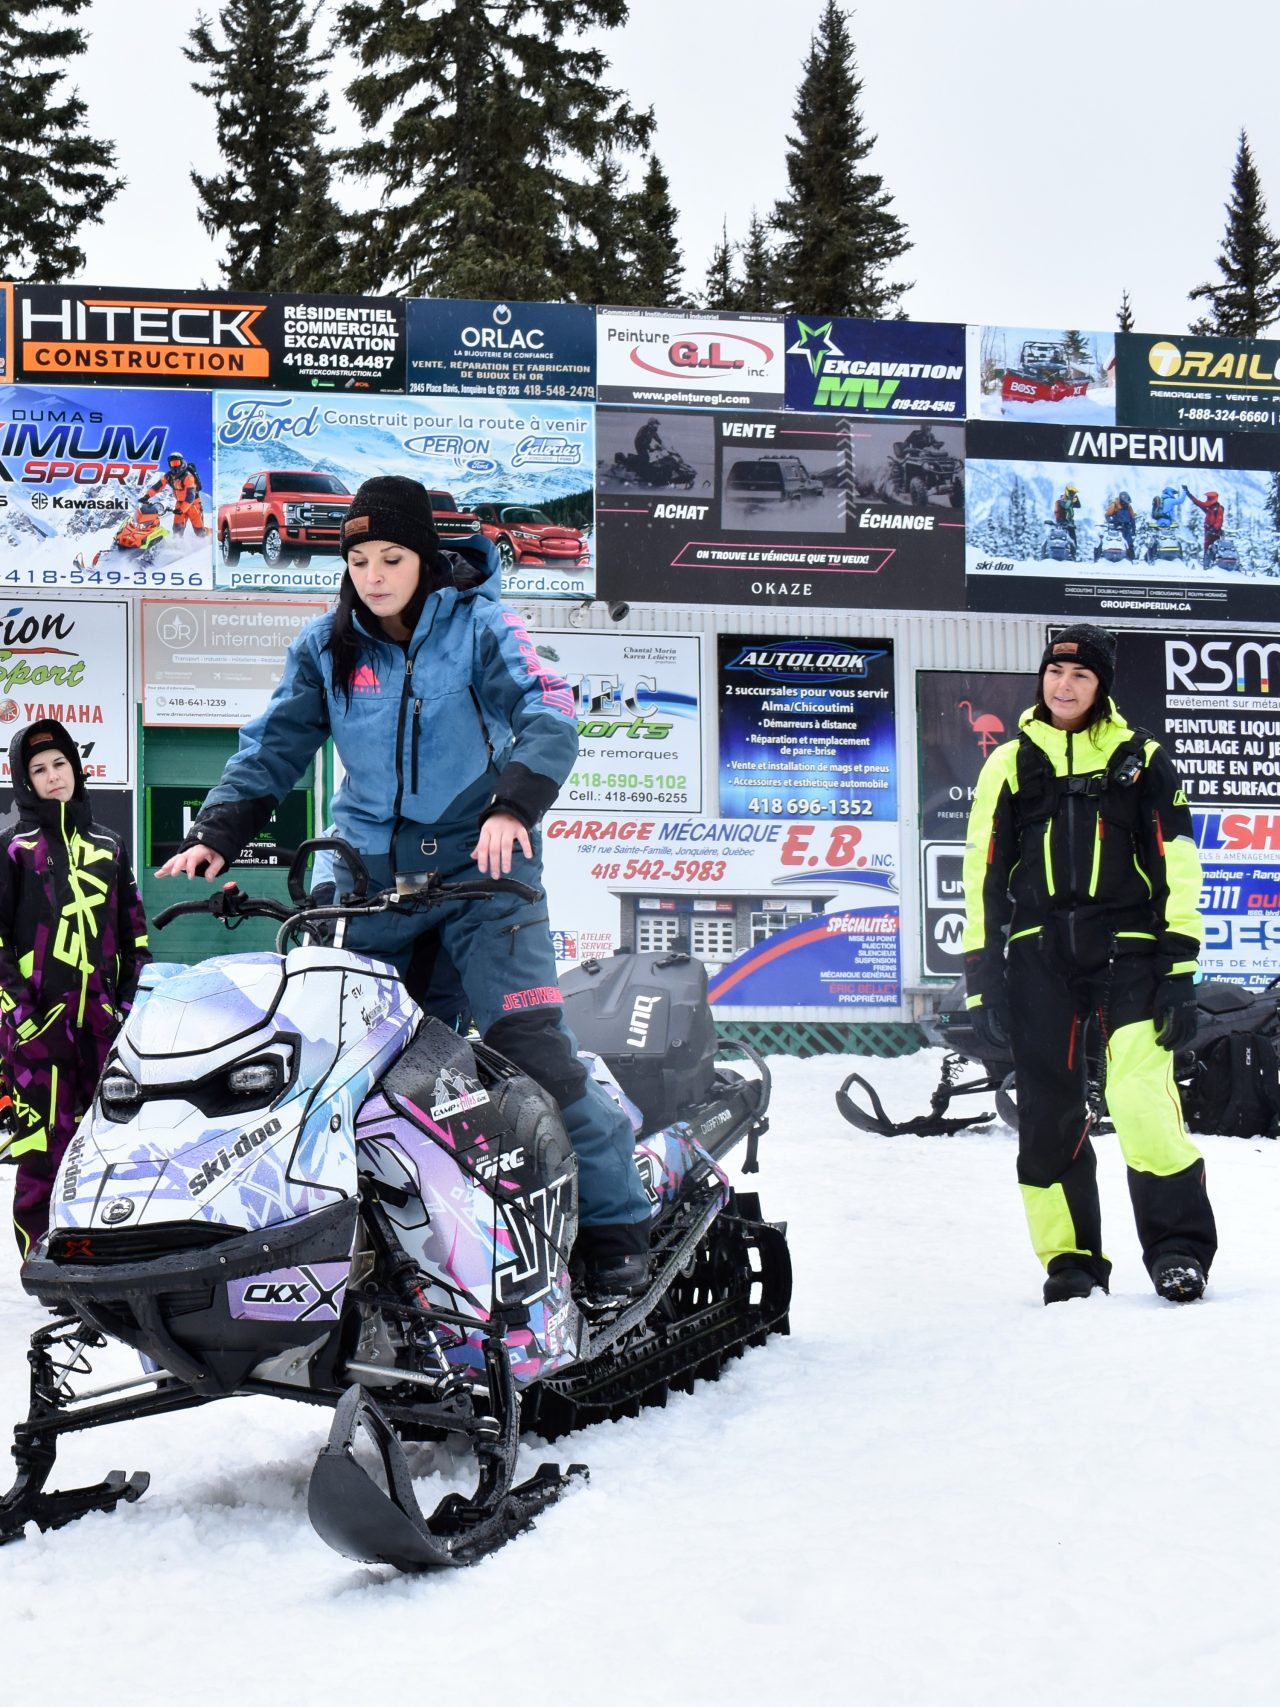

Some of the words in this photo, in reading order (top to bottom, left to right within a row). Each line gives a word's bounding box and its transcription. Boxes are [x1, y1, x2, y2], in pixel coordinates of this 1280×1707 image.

[284, 304, 396, 322] RÉSIDENTIEL
[22, 299, 263, 346] HITECK
[284, 321, 399, 337] COMMERCIAL
[284, 335, 396, 351] EXCAVATION
[461, 327, 544, 349] ORLAC
[608, 328, 670, 344] Peinture
[35, 348, 245, 372] CONSTRUCTION
[283, 353, 394, 369] 418.818.4487
[464, 350, 501, 358] BIJOUTERIE
[668, 341, 744, 369] G.L.
[450, 361, 509, 371] RÉPARATION
[527, 365, 590, 373] FABRICATION
[748, 367, 769, 377] inc.
[822, 360, 963, 380] EXCAVATION
[477, 372, 510, 380] BIJOUX
[426, 383, 441, 392] Place
[524, 385, 595, 397] 418-548-2479
[814, 376, 900, 409] MV
[1010, 381, 1036, 395] BOSS
[633, 391, 750, 405] www.peinturegl.com
[892, 399, 956, 412] 819-823-4545
[1226, 394, 1258, 402] VENTE
[13, 409, 103, 424] DUMAS
[219, 399, 319, 445] Ford
[323, 410, 408, 427] Construit
[413, 416, 453, 431] pour
[458, 414, 478, 429] la
[480, 417, 524, 432] route
[530, 415, 540, 431] à
[545, 419, 588, 432] venir
[1178, 408, 1268, 422] 1-888-324-6660
[722, 422, 776, 439] VENTE
[1068, 431, 1224, 462] IMPERIUM
[22, 461, 159, 486] SPORT
[53, 496, 129, 510] Kawasaki
[654, 504, 709, 521] ACHAT
[859, 509, 935, 531] ÉCHANGE
[696, 550, 709, 560] ON
[711, 551, 747, 562] TROUVE
[749, 552, 759, 561] LE
[761, 550, 806, 562] VÉHICULE
[808, 553, 826, 564] QUE
[828, 554, 840, 564] TU
[842, 555, 869, 565] VEUX!
[976, 561, 1014, 572] ski-doo
[5, 570, 203, 586] 418-549-3956
[751, 582, 813, 597] OKAZE
[1100, 600, 1191, 611] GROUPEIMPERIUM.CA
[740, 652, 866, 668] AUTOLOOK
[725, 685, 733, 695] 2
[735, 686, 798, 697] succursales
[800, 688, 826, 698] pour
[829, 689, 855, 697] vous
[857, 689, 889, 698] servir
[169, 698, 227, 707] 418-641-1239
[762, 701, 853, 713] Alma/Chicoutimi
[1169, 697, 1229, 708] revêtement
[1233, 699, 1248, 708] sur
[24, 703, 104, 724] YAMAHA
[764, 719, 813, 729] Démarreurs
[815, 720, 820, 729] à
[822, 721, 857, 729] distance
[1165, 718, 1236, 734] PEINTURE
[751, 735, 797, 745] Réparation
[800, 736, 808, 744] et
[809, 737, 870, 747] remplacement
[1175, 739, 1239, 754] SABLAGE
[1243, 741, 1264, 755] AU
[601, 749, 678, 760] remorques
[780, 746, 791, 755] de
[793, 747, 836, 756] pare-brise
[731, 761, 756, 770] Vente
[758, 762, 766, 770] et
[768, 762, 816, 772] installation
[817, 763, 828, 772] de
[830, 764, 852, 773] mags
[854, 764, 863, 772] et
[864, 766, 889, 774] pneus
[1230, 761, 1248, 775] EN
[569, 773, 687, 789] 418-690-5102
[734, 777, 781, 786] Accessoires
[784, 778, 792, 787] et
[840, 779, 888, 789] automobile
[1199, 780, 1218, 795] DE
[605, 792, 687, 803] 418-690-6255
[749, 798, 783, 813] 418
[787, 799, 873, 815] 696-1352
[546, 820, 655, 841] GARAGE
[658, 819, 782, 842] MÉCANIQUE
[577, 845, 596, 854] 1981
[598, 846, 611, 854] rue
[613, 846, 674, 855] Sainte-Famille,
[722, 847, 755, 857] Québec
[780, 824, 867, 868] E.B.
[871, 853, 895, 867] INC.
[591, 863, 620, 879] 418
[623, 858, 727, 882] 542-5983
[52, 822, 113, 969] FXR
[827, 914, 896, 932] SPÉCIALITÉS:
[580, 933, 611, 941] ATELIER
[580, 942, 612, 950] SERVICE
[839, 994, 897, 1002] PROPRIÉTAIRE
[434, 1105, 456, 1117] CAMP
[188, 1118, 282, 1197] ski-doo
[63, 1136, 85, 1201] ski-doo
[242, 1283, 310, 1303] CKX
